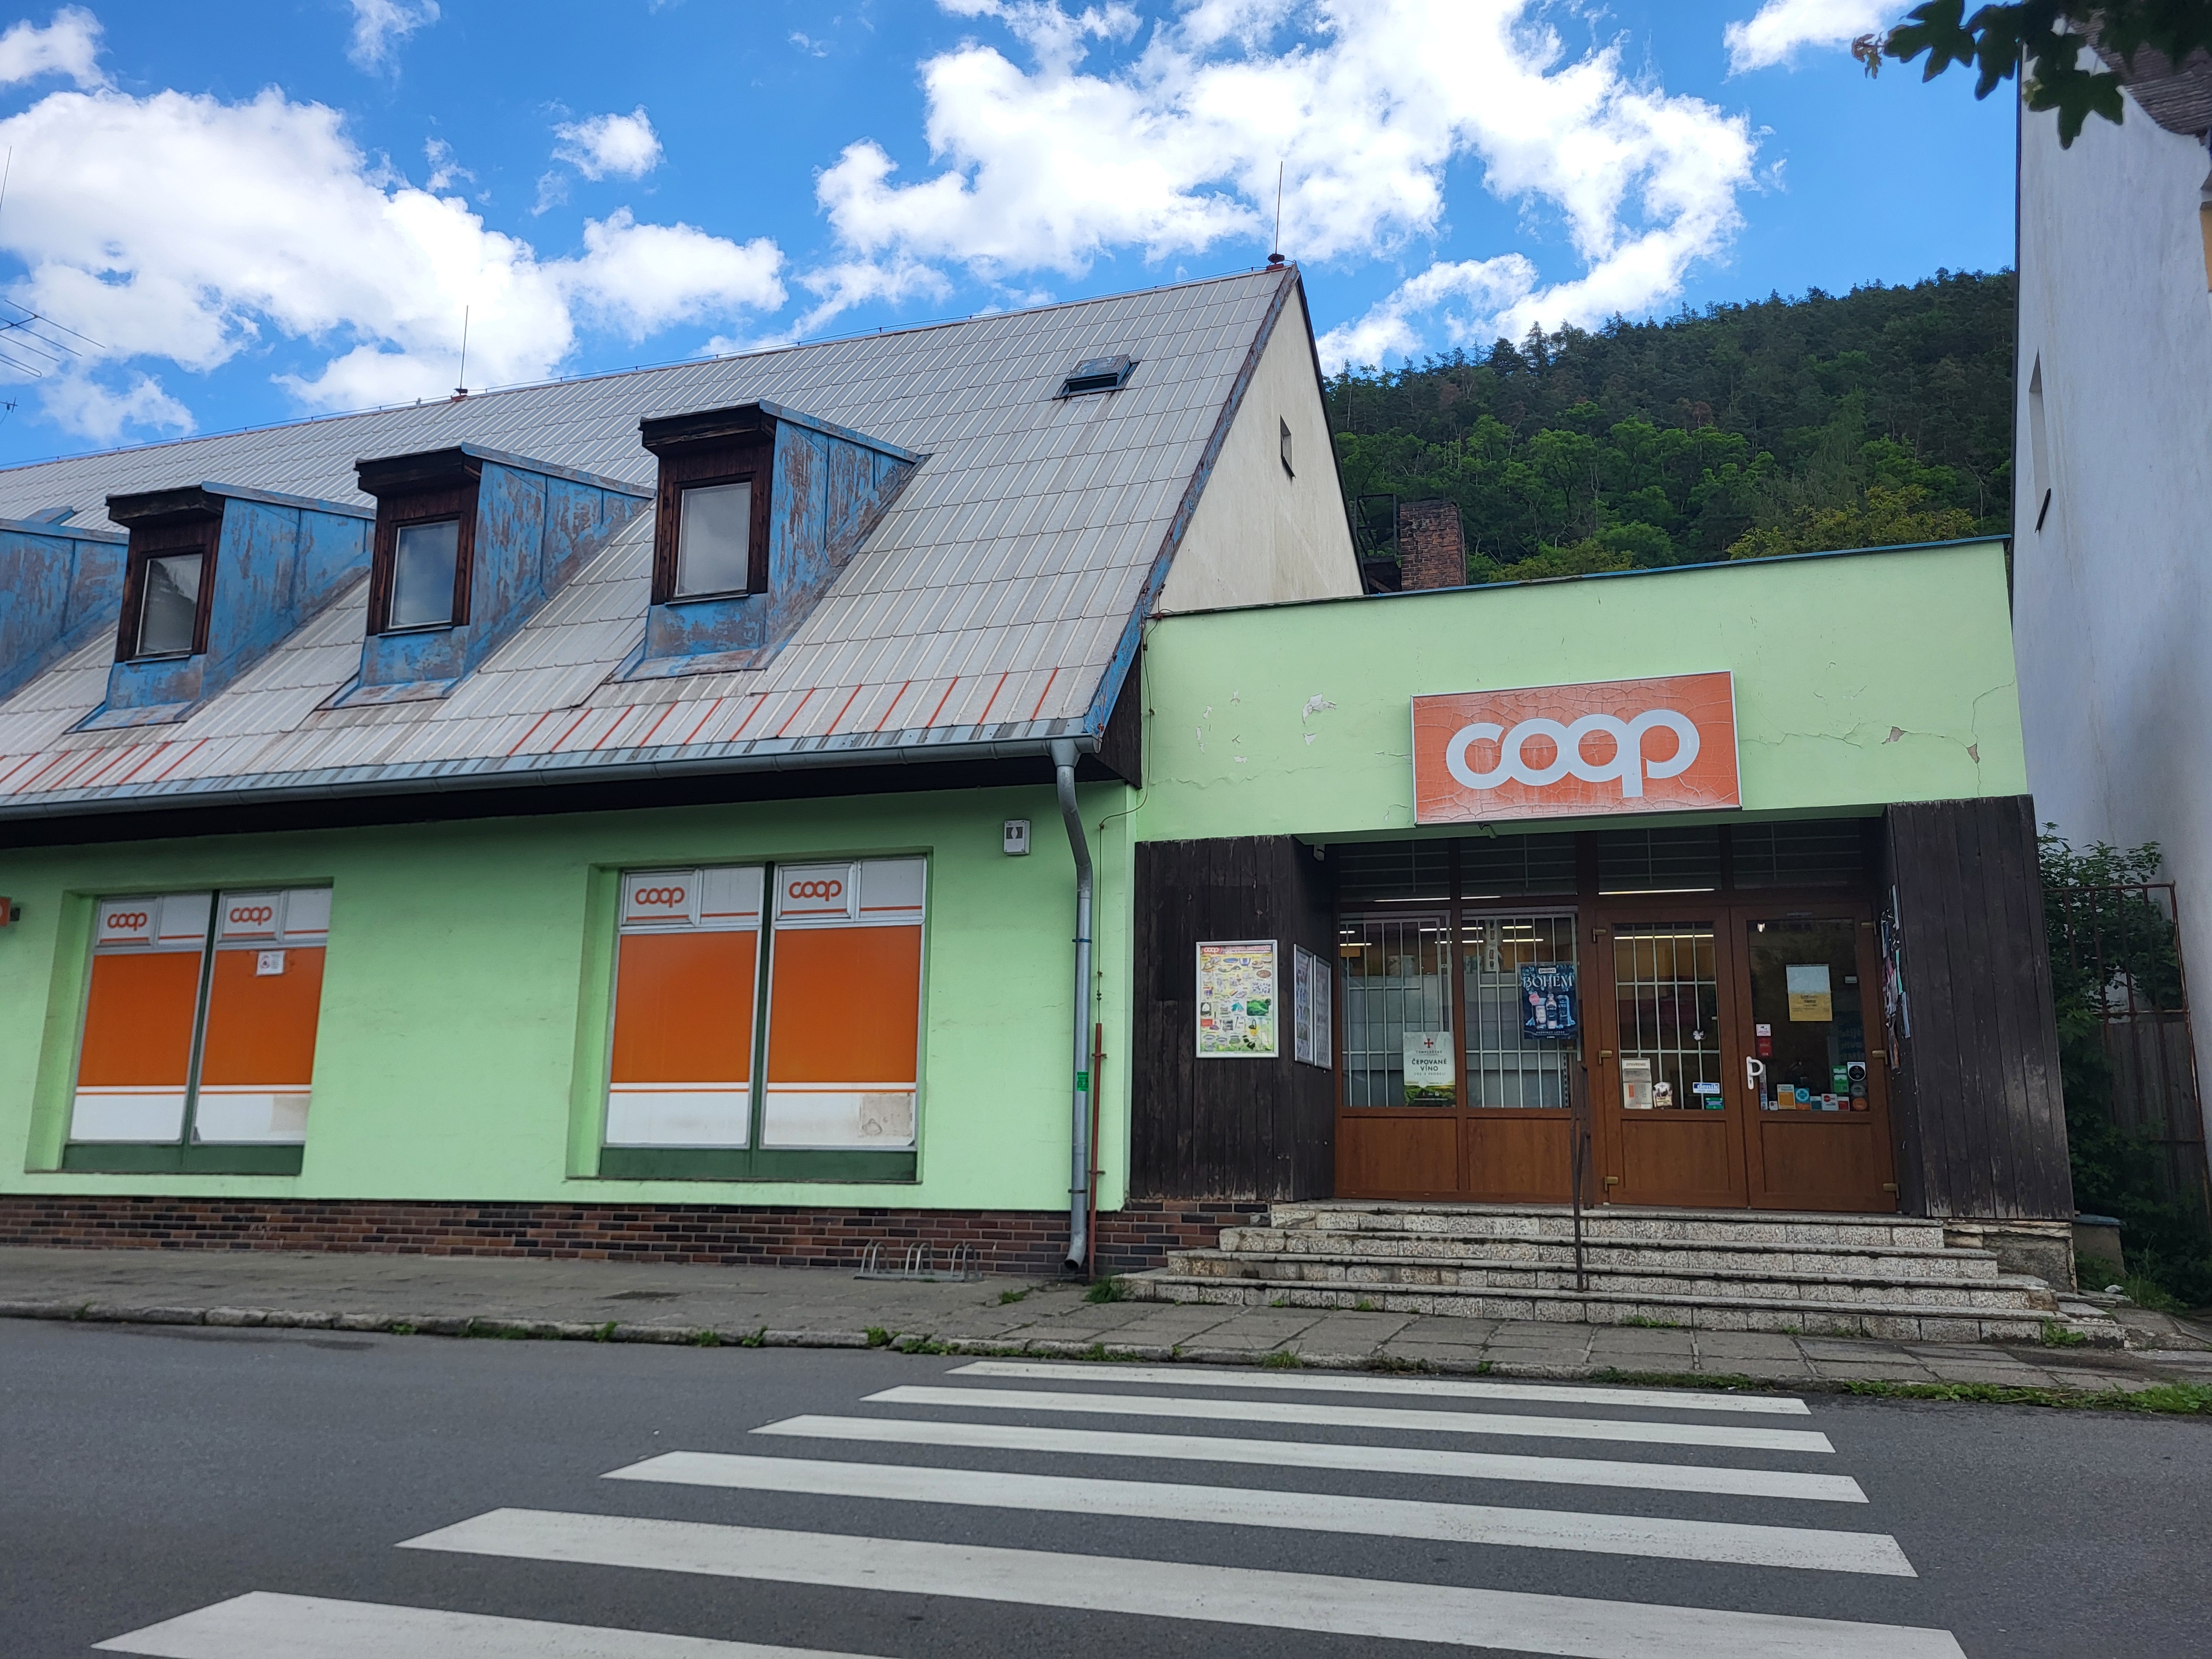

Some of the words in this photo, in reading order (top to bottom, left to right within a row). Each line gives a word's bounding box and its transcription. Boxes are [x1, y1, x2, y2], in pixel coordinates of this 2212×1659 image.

[1445, 708, 1700, 798] coop
[634, 886, 685, 907] coop
[788, 879, 842, 901] coop
[107, 912, 147, 931] coop
[229, 906, 272, 925] coop
